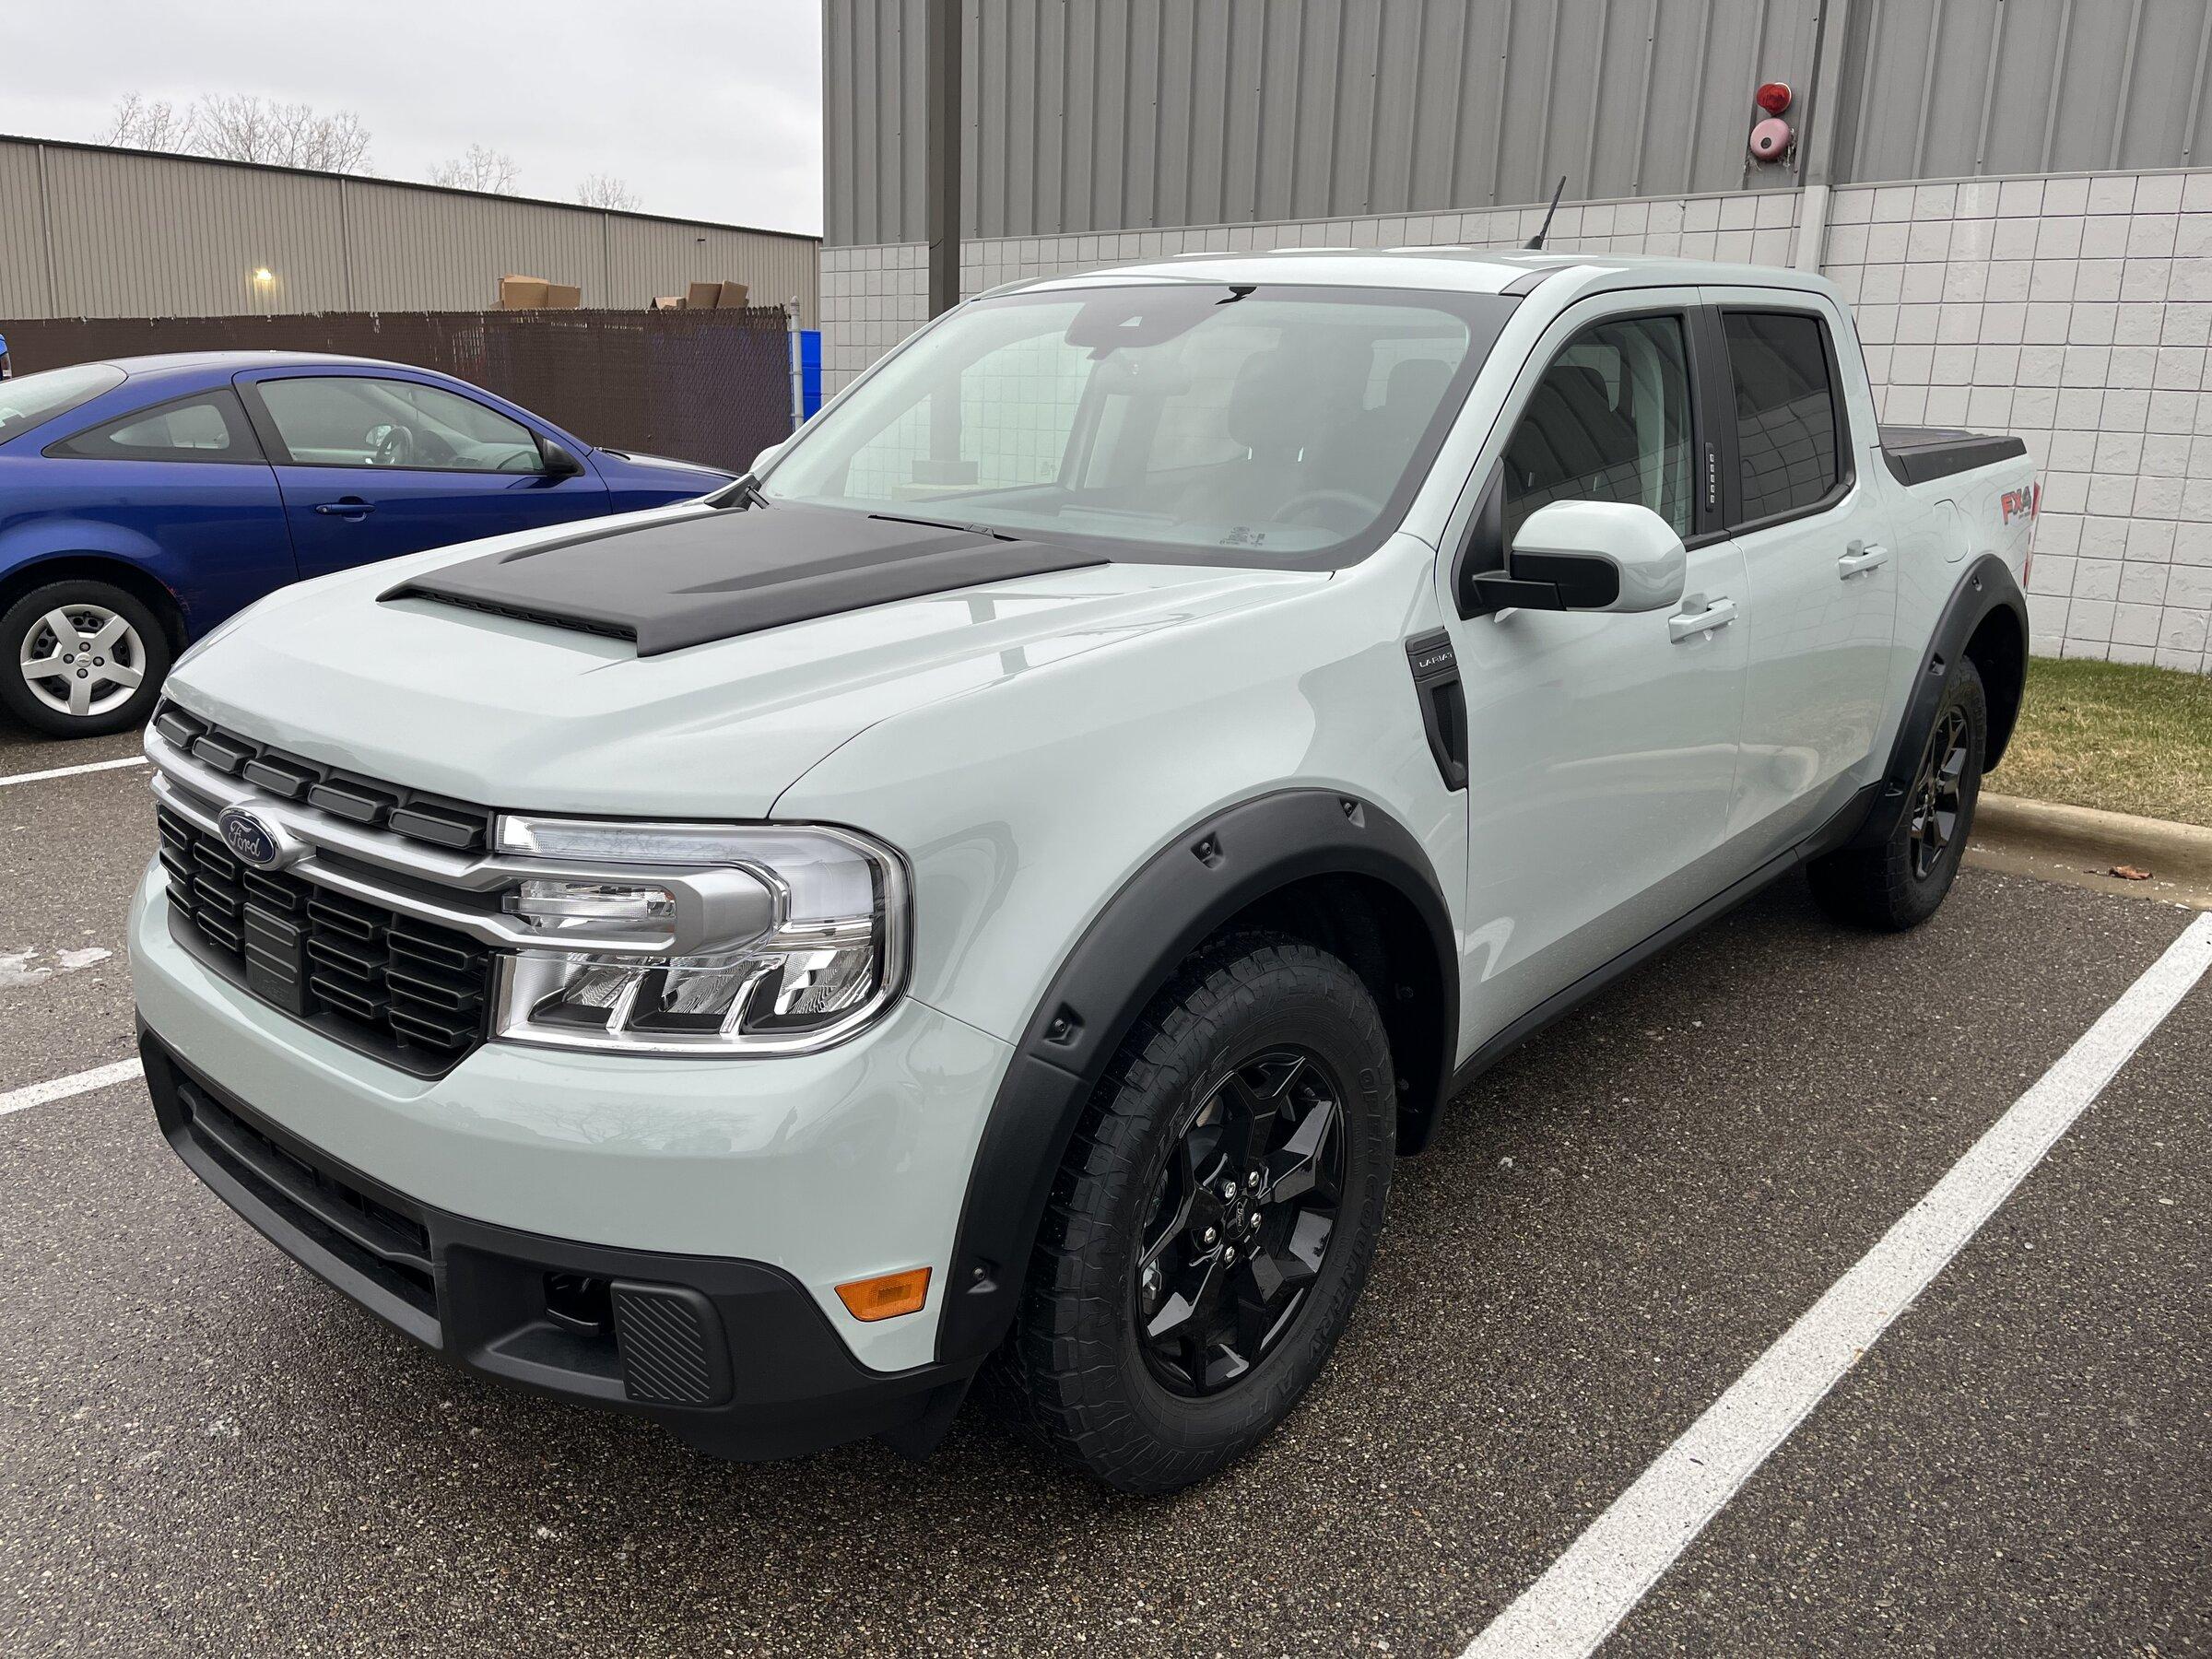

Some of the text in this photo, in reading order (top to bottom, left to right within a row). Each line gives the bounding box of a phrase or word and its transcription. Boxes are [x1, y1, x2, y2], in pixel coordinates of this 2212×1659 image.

[2000, 486, 2031, 525] FX4
[1418, 653, 1453, 668] LARIAT
[229, 820, 261, 856] Ford
